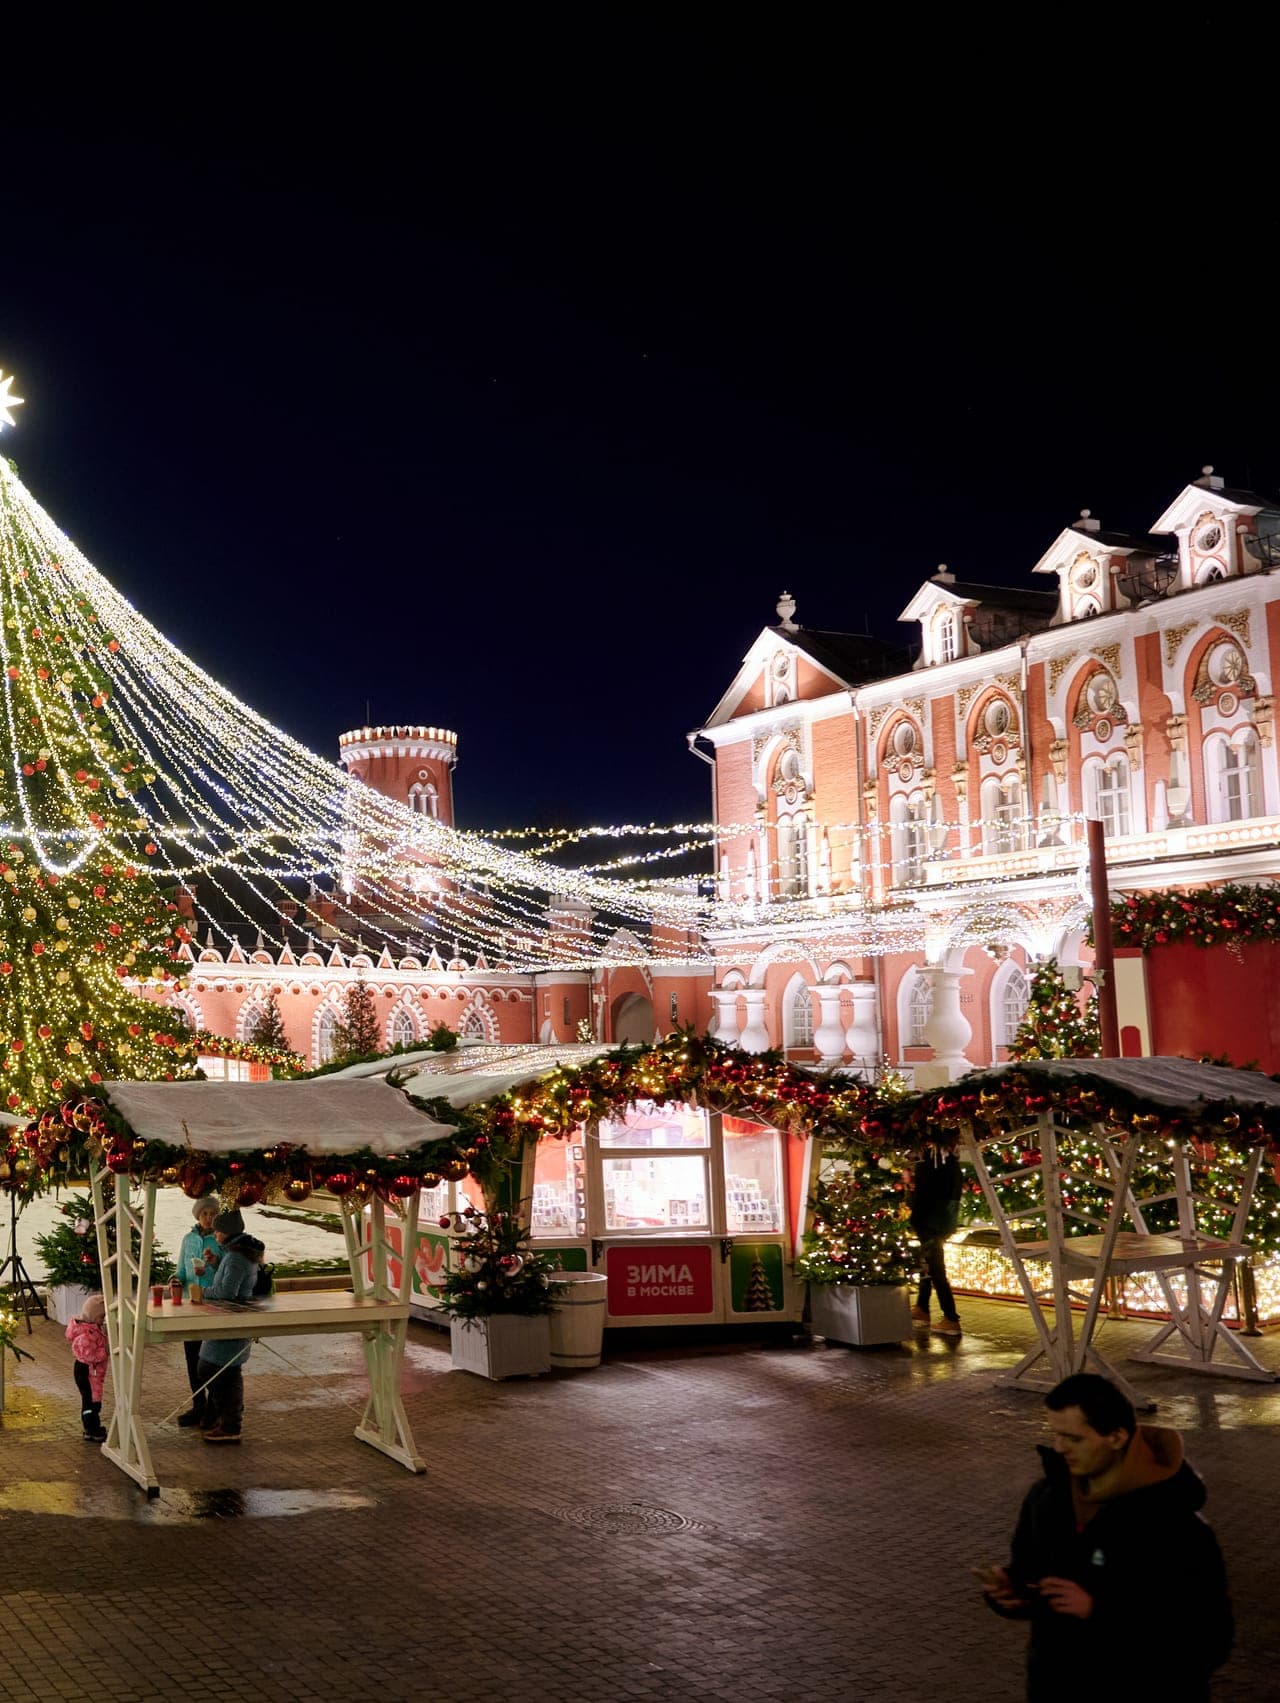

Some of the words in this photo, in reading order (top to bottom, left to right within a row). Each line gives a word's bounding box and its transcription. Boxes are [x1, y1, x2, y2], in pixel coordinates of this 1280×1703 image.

[627, 1264, 694, 1283] ЗИМА
[627, 1286, 637, 1297] В
[640, 1285, 695, 1297] МОСКВЕ
